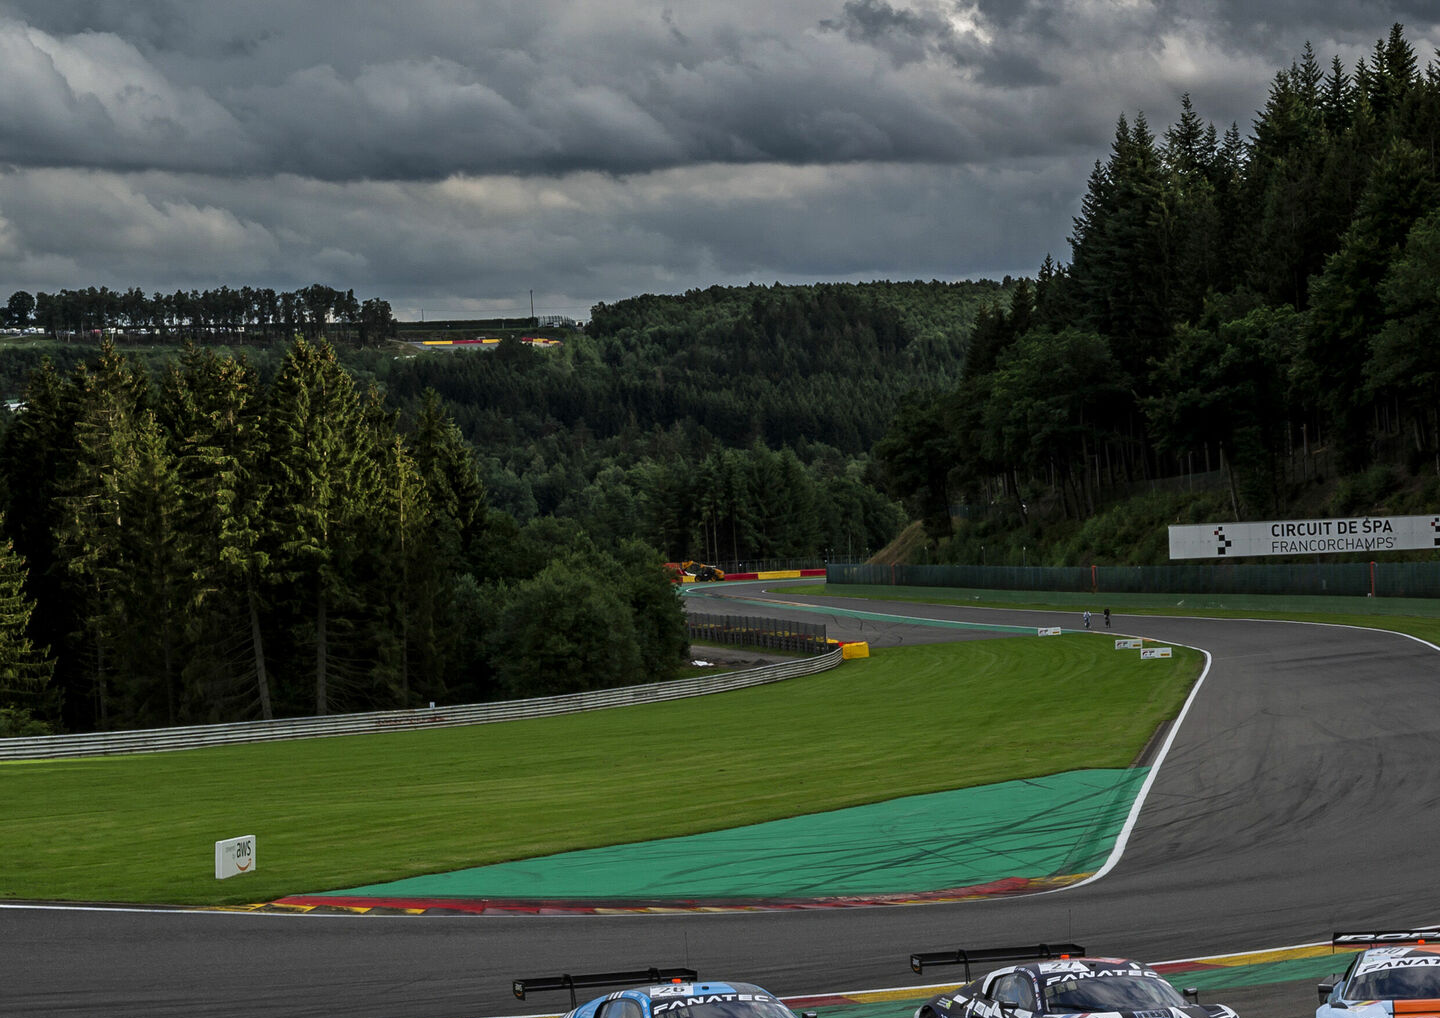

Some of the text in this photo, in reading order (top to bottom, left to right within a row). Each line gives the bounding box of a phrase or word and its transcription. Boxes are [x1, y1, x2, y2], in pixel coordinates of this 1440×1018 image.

[1271, 519, 1393, 538] CIRCUIT DE SPA
[1271, 536, 1394, 553] FRANCORCHAMPS
[236, 840, 252, 858] aws
[1046, 969, 1159, 987] FANATEC
[653, 994, 771, 1016] FANATEC
